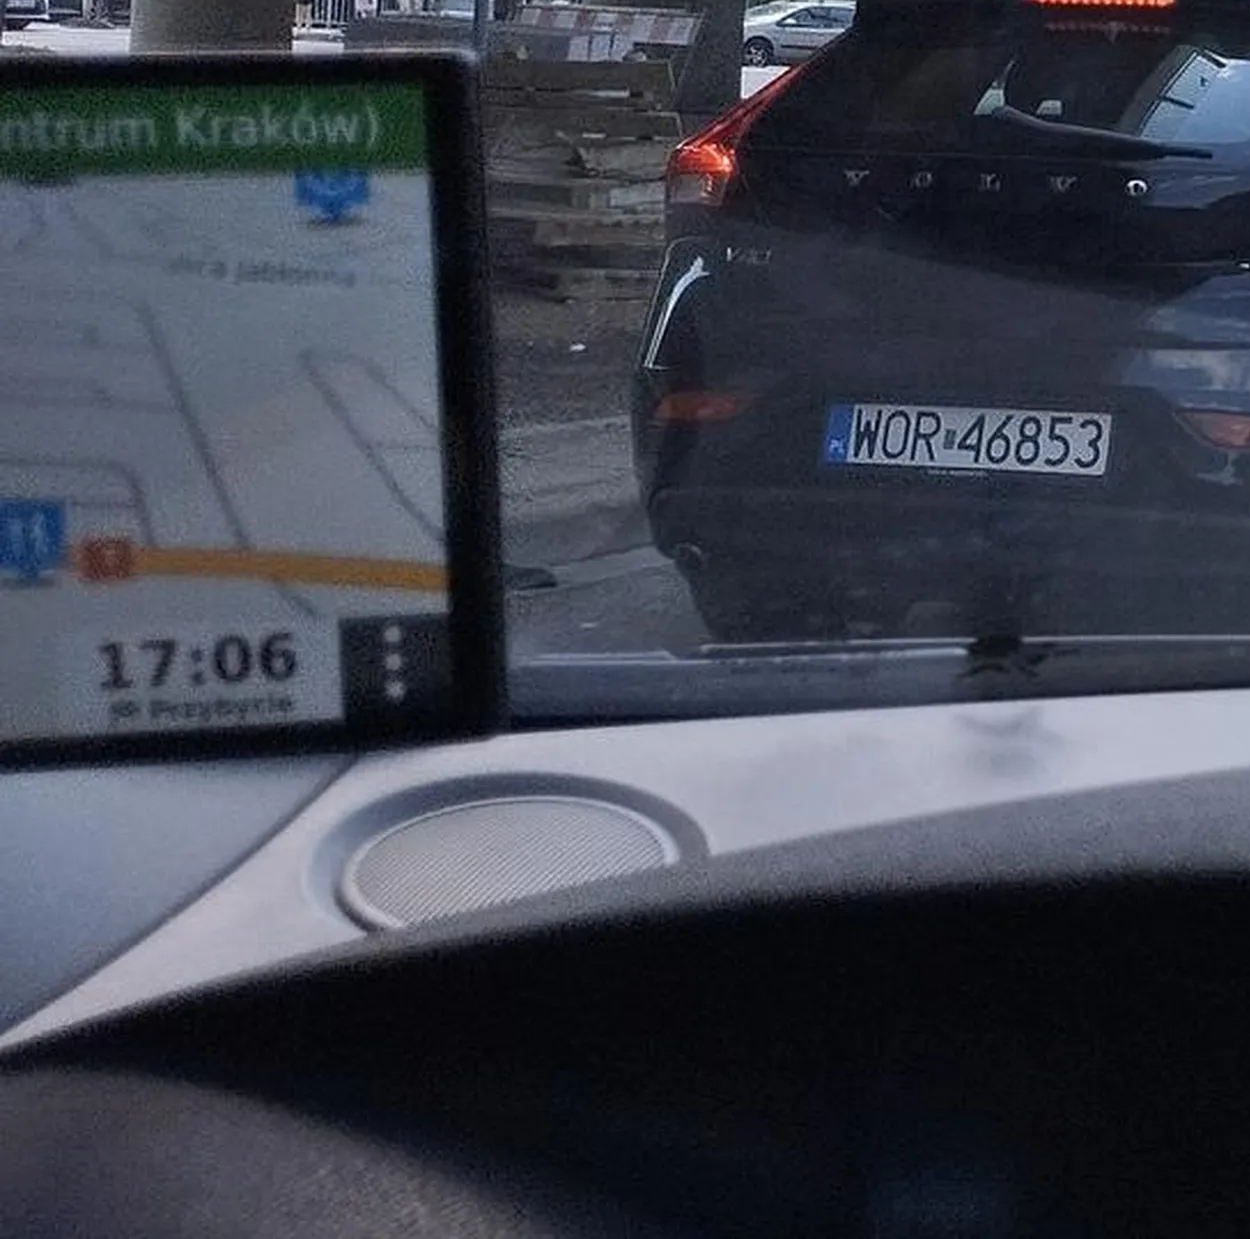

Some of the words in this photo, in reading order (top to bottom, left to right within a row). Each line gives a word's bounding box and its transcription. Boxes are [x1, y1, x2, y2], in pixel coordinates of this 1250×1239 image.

[176, 105, 379, 148] Kraków)
[852, 410, 941, 461] WOR
[956, 414, 1103, 469] 46853
[99, 633, 298, 689] 17:06
